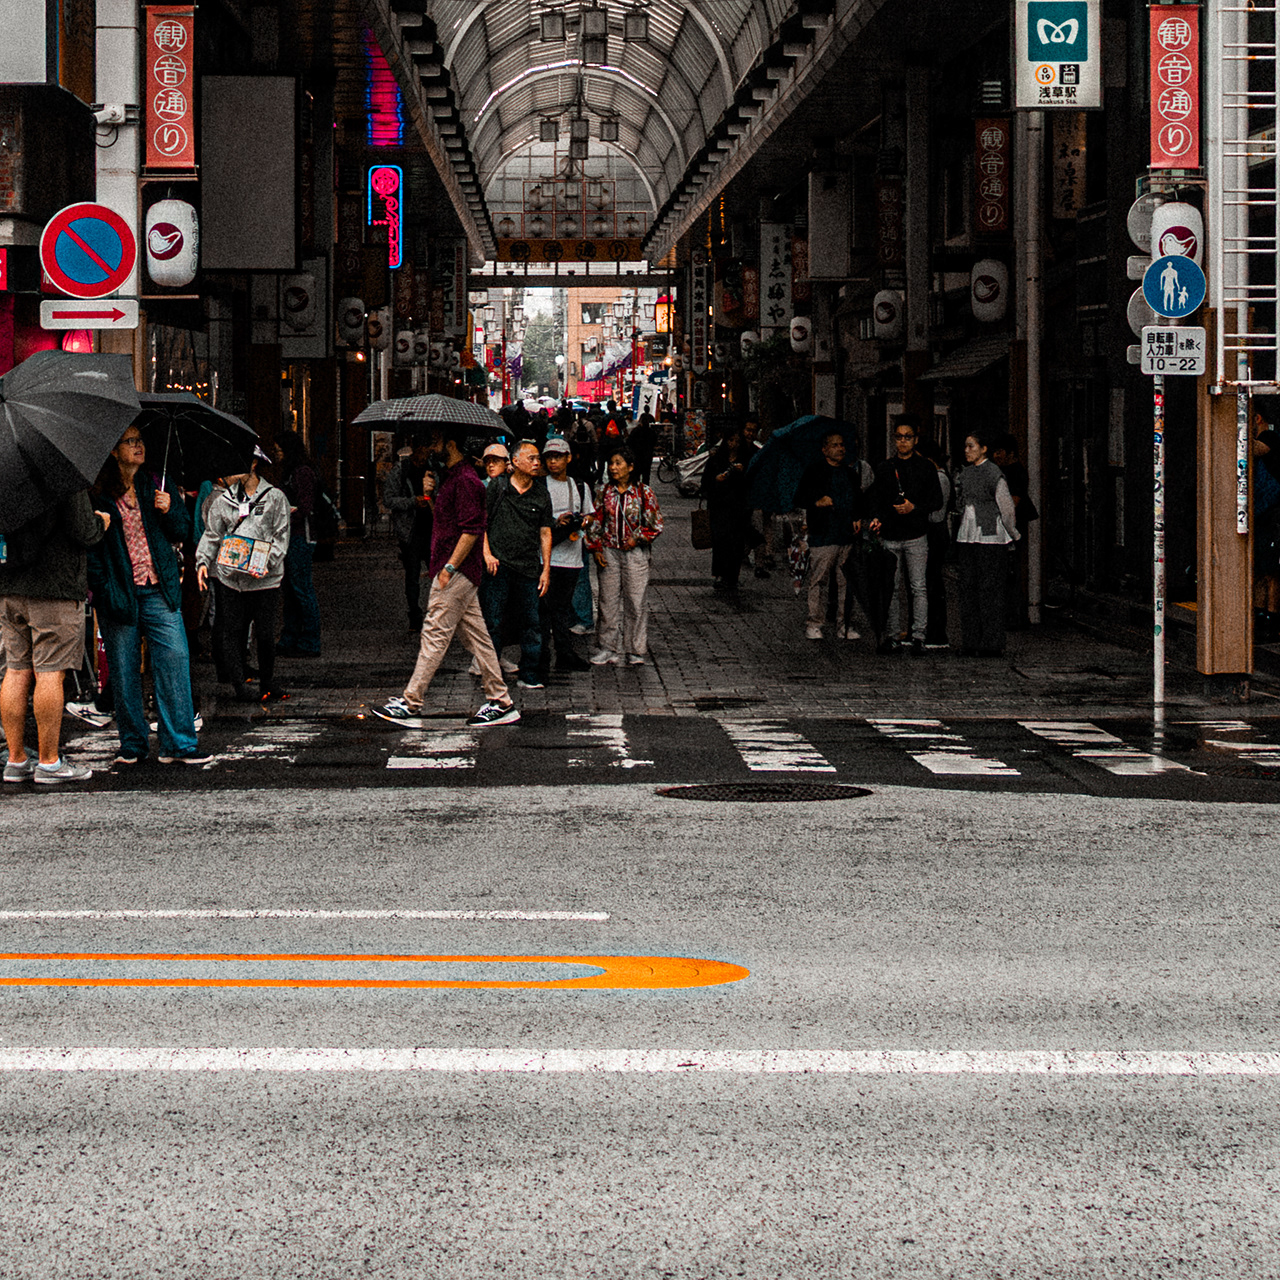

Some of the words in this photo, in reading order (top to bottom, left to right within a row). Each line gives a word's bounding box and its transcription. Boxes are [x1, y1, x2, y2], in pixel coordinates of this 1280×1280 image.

[154, 23, 187, 154] 観音通り
[1039, 86, 1077, 98] 浅草駅
[1158, 21, 1192, 154] 観音通り
[980, 128, 1004, 225] 観音通り
[1147, 332, 1174, 344] 自転車
[1179, 338, 1201, 351] を除く
[1147, 344, 1174, 356] 人力車
